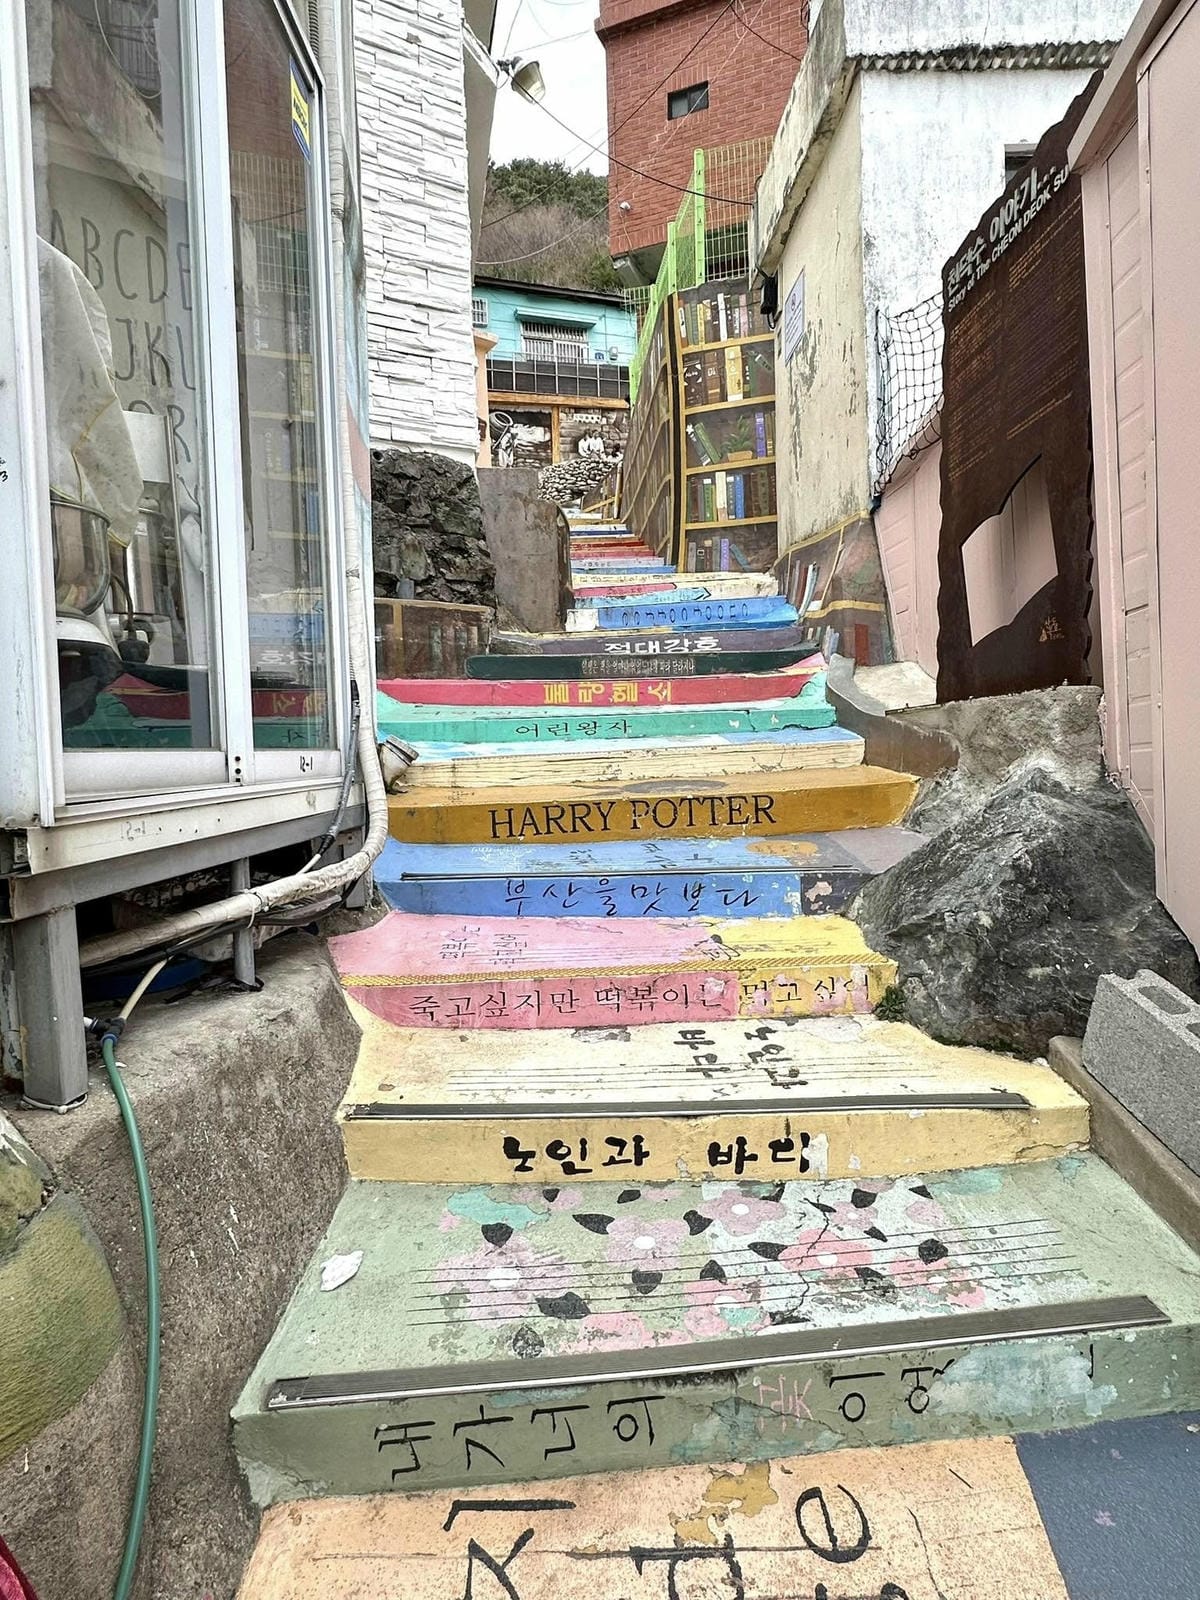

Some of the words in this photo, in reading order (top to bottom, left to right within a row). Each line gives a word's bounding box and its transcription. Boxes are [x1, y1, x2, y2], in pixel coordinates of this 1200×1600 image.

[947, 235, 987, 297] 천덕수
[948, 285, 967, 313] Story
[967, 276, 976, 291] of
[976, 259, 991, 281] The
[991, 219, 1023, 263] CHEON
[1023, 186, 1052, 228] DEOK
[515, 718, 634, 738] 어린왕자
[489, 802, 616, 840] HARRY
[630, 794, 778, 832] POTTER
[502, 1133, 650, 1175] 노인과
